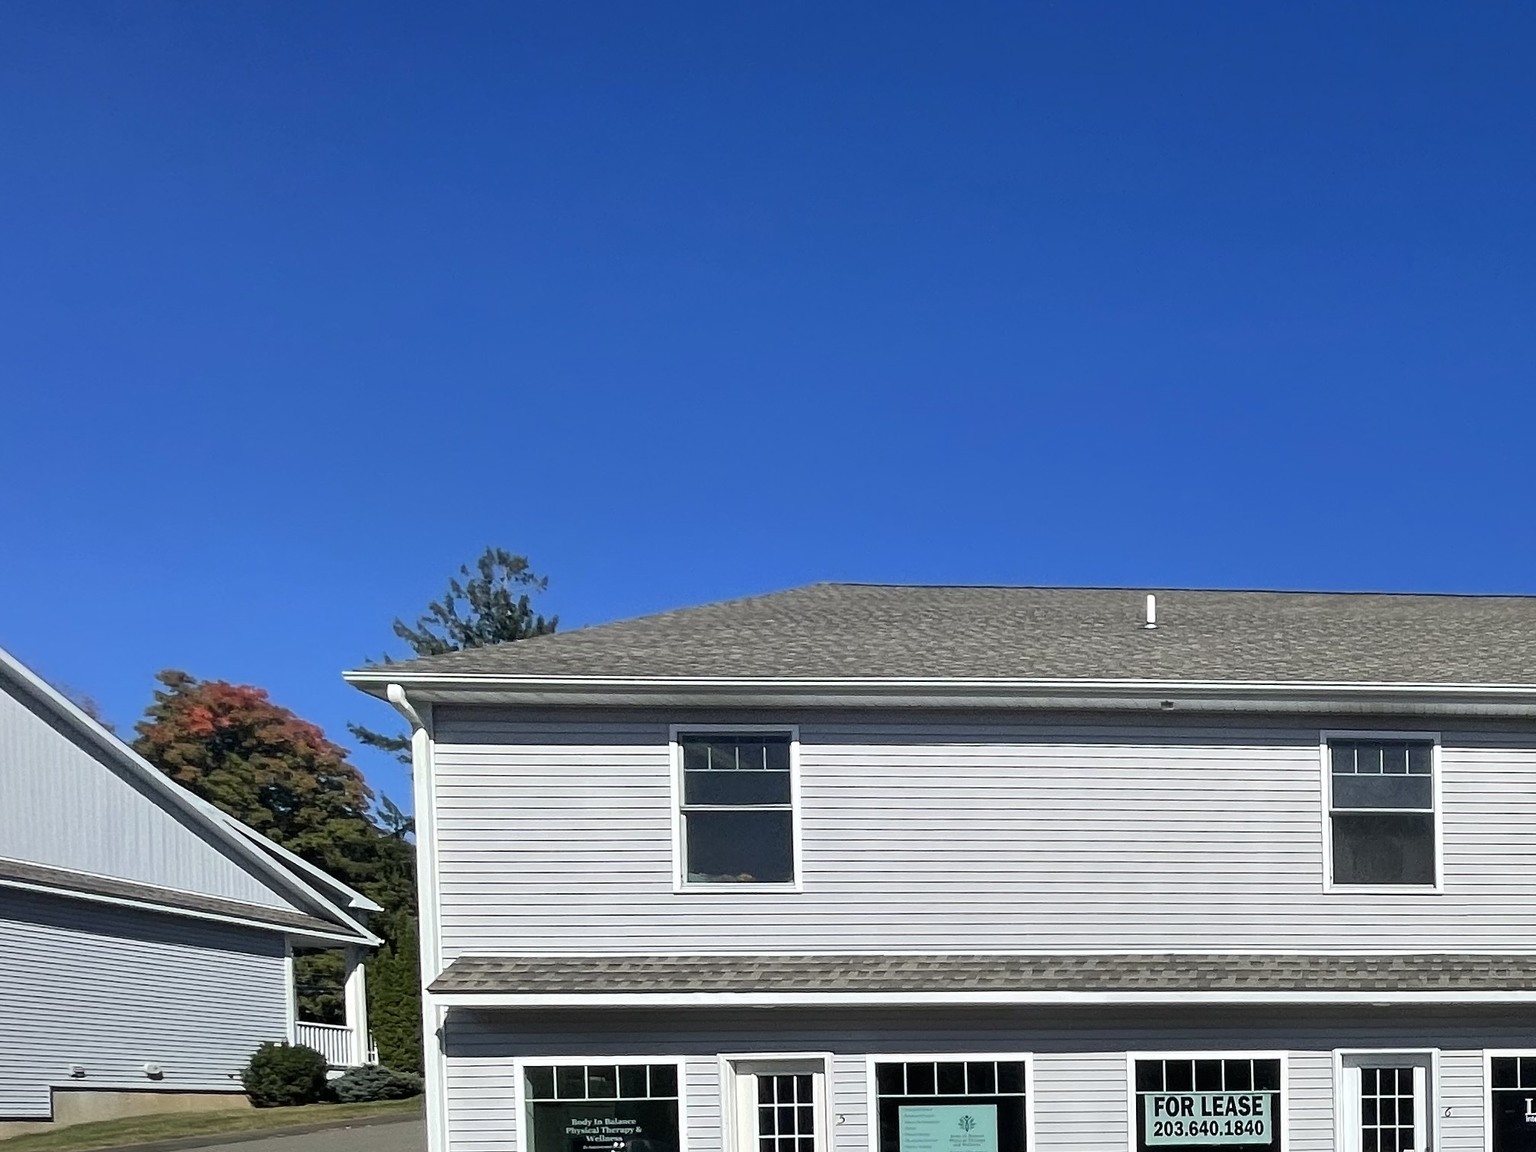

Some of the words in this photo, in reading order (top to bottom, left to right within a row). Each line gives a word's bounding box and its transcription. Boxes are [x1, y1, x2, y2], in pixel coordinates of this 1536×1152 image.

[1154, 1096, 1194, 1117] FOR
[1201, 1096, 1264, 1117] LEASE
[1445, 1107, 1452, 1117] 6
[571, 1119, 592, 1127] Body
[566, 1127, 599, 1135] Physical
[601, 1127, 634, 1135] Therapy
[1153, 1120, 1264, 1137] 203.640.1840
